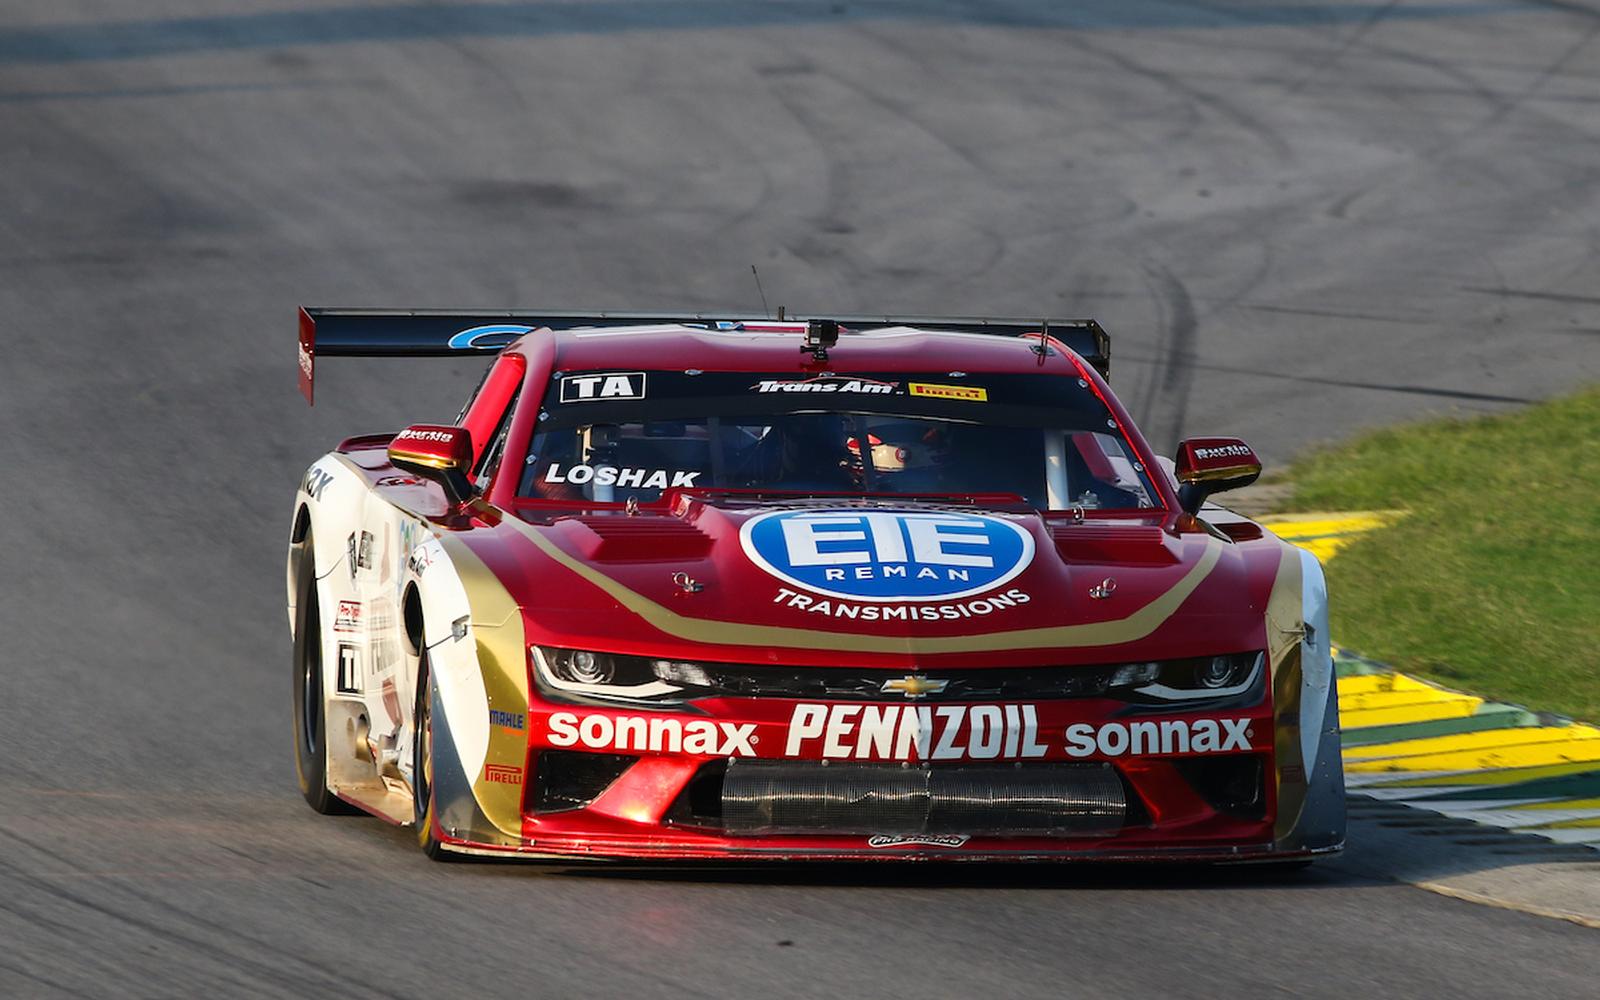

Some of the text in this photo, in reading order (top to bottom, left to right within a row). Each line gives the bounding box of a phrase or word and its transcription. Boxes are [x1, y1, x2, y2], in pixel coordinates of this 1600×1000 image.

[572, 376, 634, 398] TA
[759, 380, 893, 394] Trans Am
[545, 464, 701, 489] LOSHAK
[825, 566, 969, 581] REMAN
[773, 588, 1031, 621] TRANSMISSIONS
[490, 709, 524, 729] MAHLE
[785, 703, 1049, 760] PENNZOIL
[485, 763, 522, 785] PIRELLI
